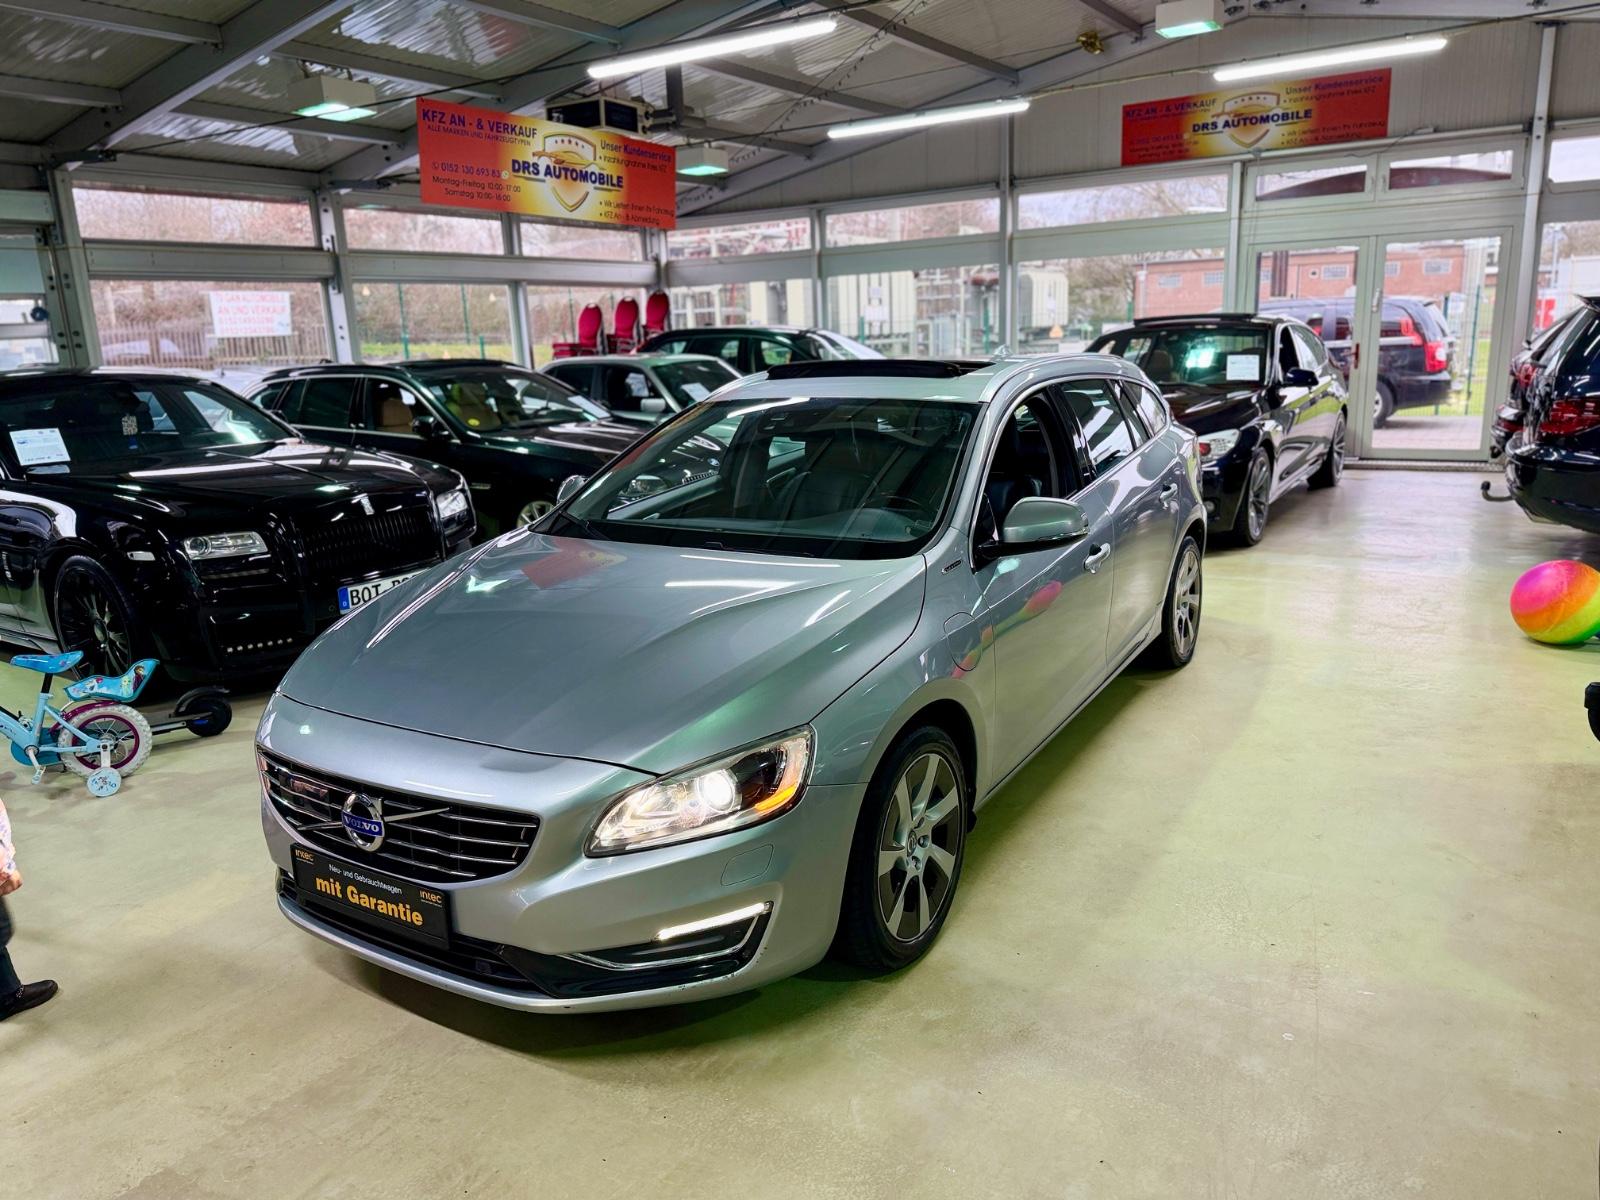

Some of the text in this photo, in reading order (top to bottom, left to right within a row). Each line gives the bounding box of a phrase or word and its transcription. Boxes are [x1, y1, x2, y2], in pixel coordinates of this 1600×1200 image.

[1174, 98, 1217, 110] VERKAUF
[422, 108, 446, 124] KFZ
[449, 113, 466, 128] AN
[476, 118, 484, 130] &
[487, 120, 537, 139] VERKAUF
[1191, 121, 1218, 133] DRS
[1222, 108, 1312, 129] AUTOMOBILE
[427, 124, 531, 147] ALLE MARKEN UND FAHRZEUGTYPEN
[600, 140, 672, 163] Unser Kundenservice
[441, 162, 460, 172] 0152
[461, 164, 475, 175] 130
[476, 167, 490, 178] 693
[511, 159, 623, 188] DRS AUTOMOBILE
[432, 175, 486, 190] Montag-Freitag
[445, 188, 476, 200] Samstag
[350, 583, 381, 606] BOT
[344, 815, 380, 833] VOLVO
[329, 863, 403, 896] Neu- und Gebrauchtwagen
[315, 876, 423, 926] mit Garantie
